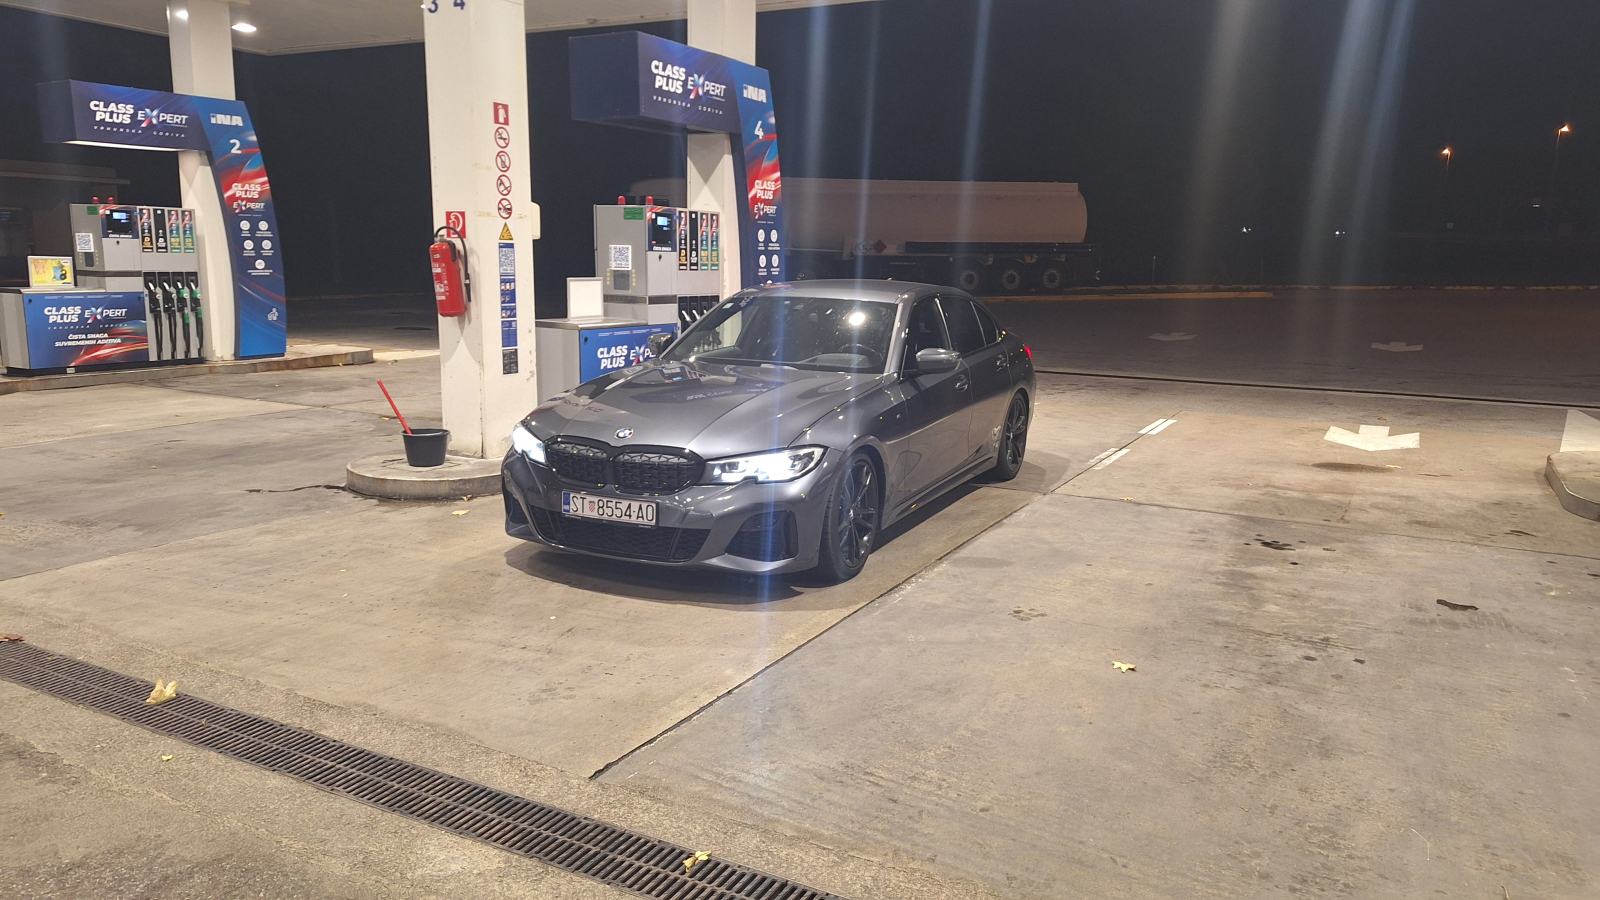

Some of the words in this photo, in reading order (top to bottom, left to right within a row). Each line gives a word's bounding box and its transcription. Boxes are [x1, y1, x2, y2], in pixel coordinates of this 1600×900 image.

[651, 60, 686, 80] CLASS
[655, 76, 683, 94] PLUS
[687, 73, 727, 99] EXPERT
[89, 100, 134, 115] CLASS
[95, 111, 131, 124] PLUS
[137, 108, 188, 127] EXPERT
[754, 120, 764, 139] 4
[229, 139, 242, 154] 2
[232, 183, 261, 192] CLASS
[755, 180, 776, 190] CLASS
[235, 190, 260, 199] PLUS
[756, 190, 774, 199] PLUS
[232, 200, 265, 213] EXPERT
[754, 202, 777, 219] EXPERT
[44, 306, 82, 316] CLASS
[84, 307, 128, 324] EXPERT
[49, 314, 79, 323] PLUS
[597, 345, 628, 358] CLASS
[600, 356, 625, 369] PLUS
[571, 495, 587, 513] ST
